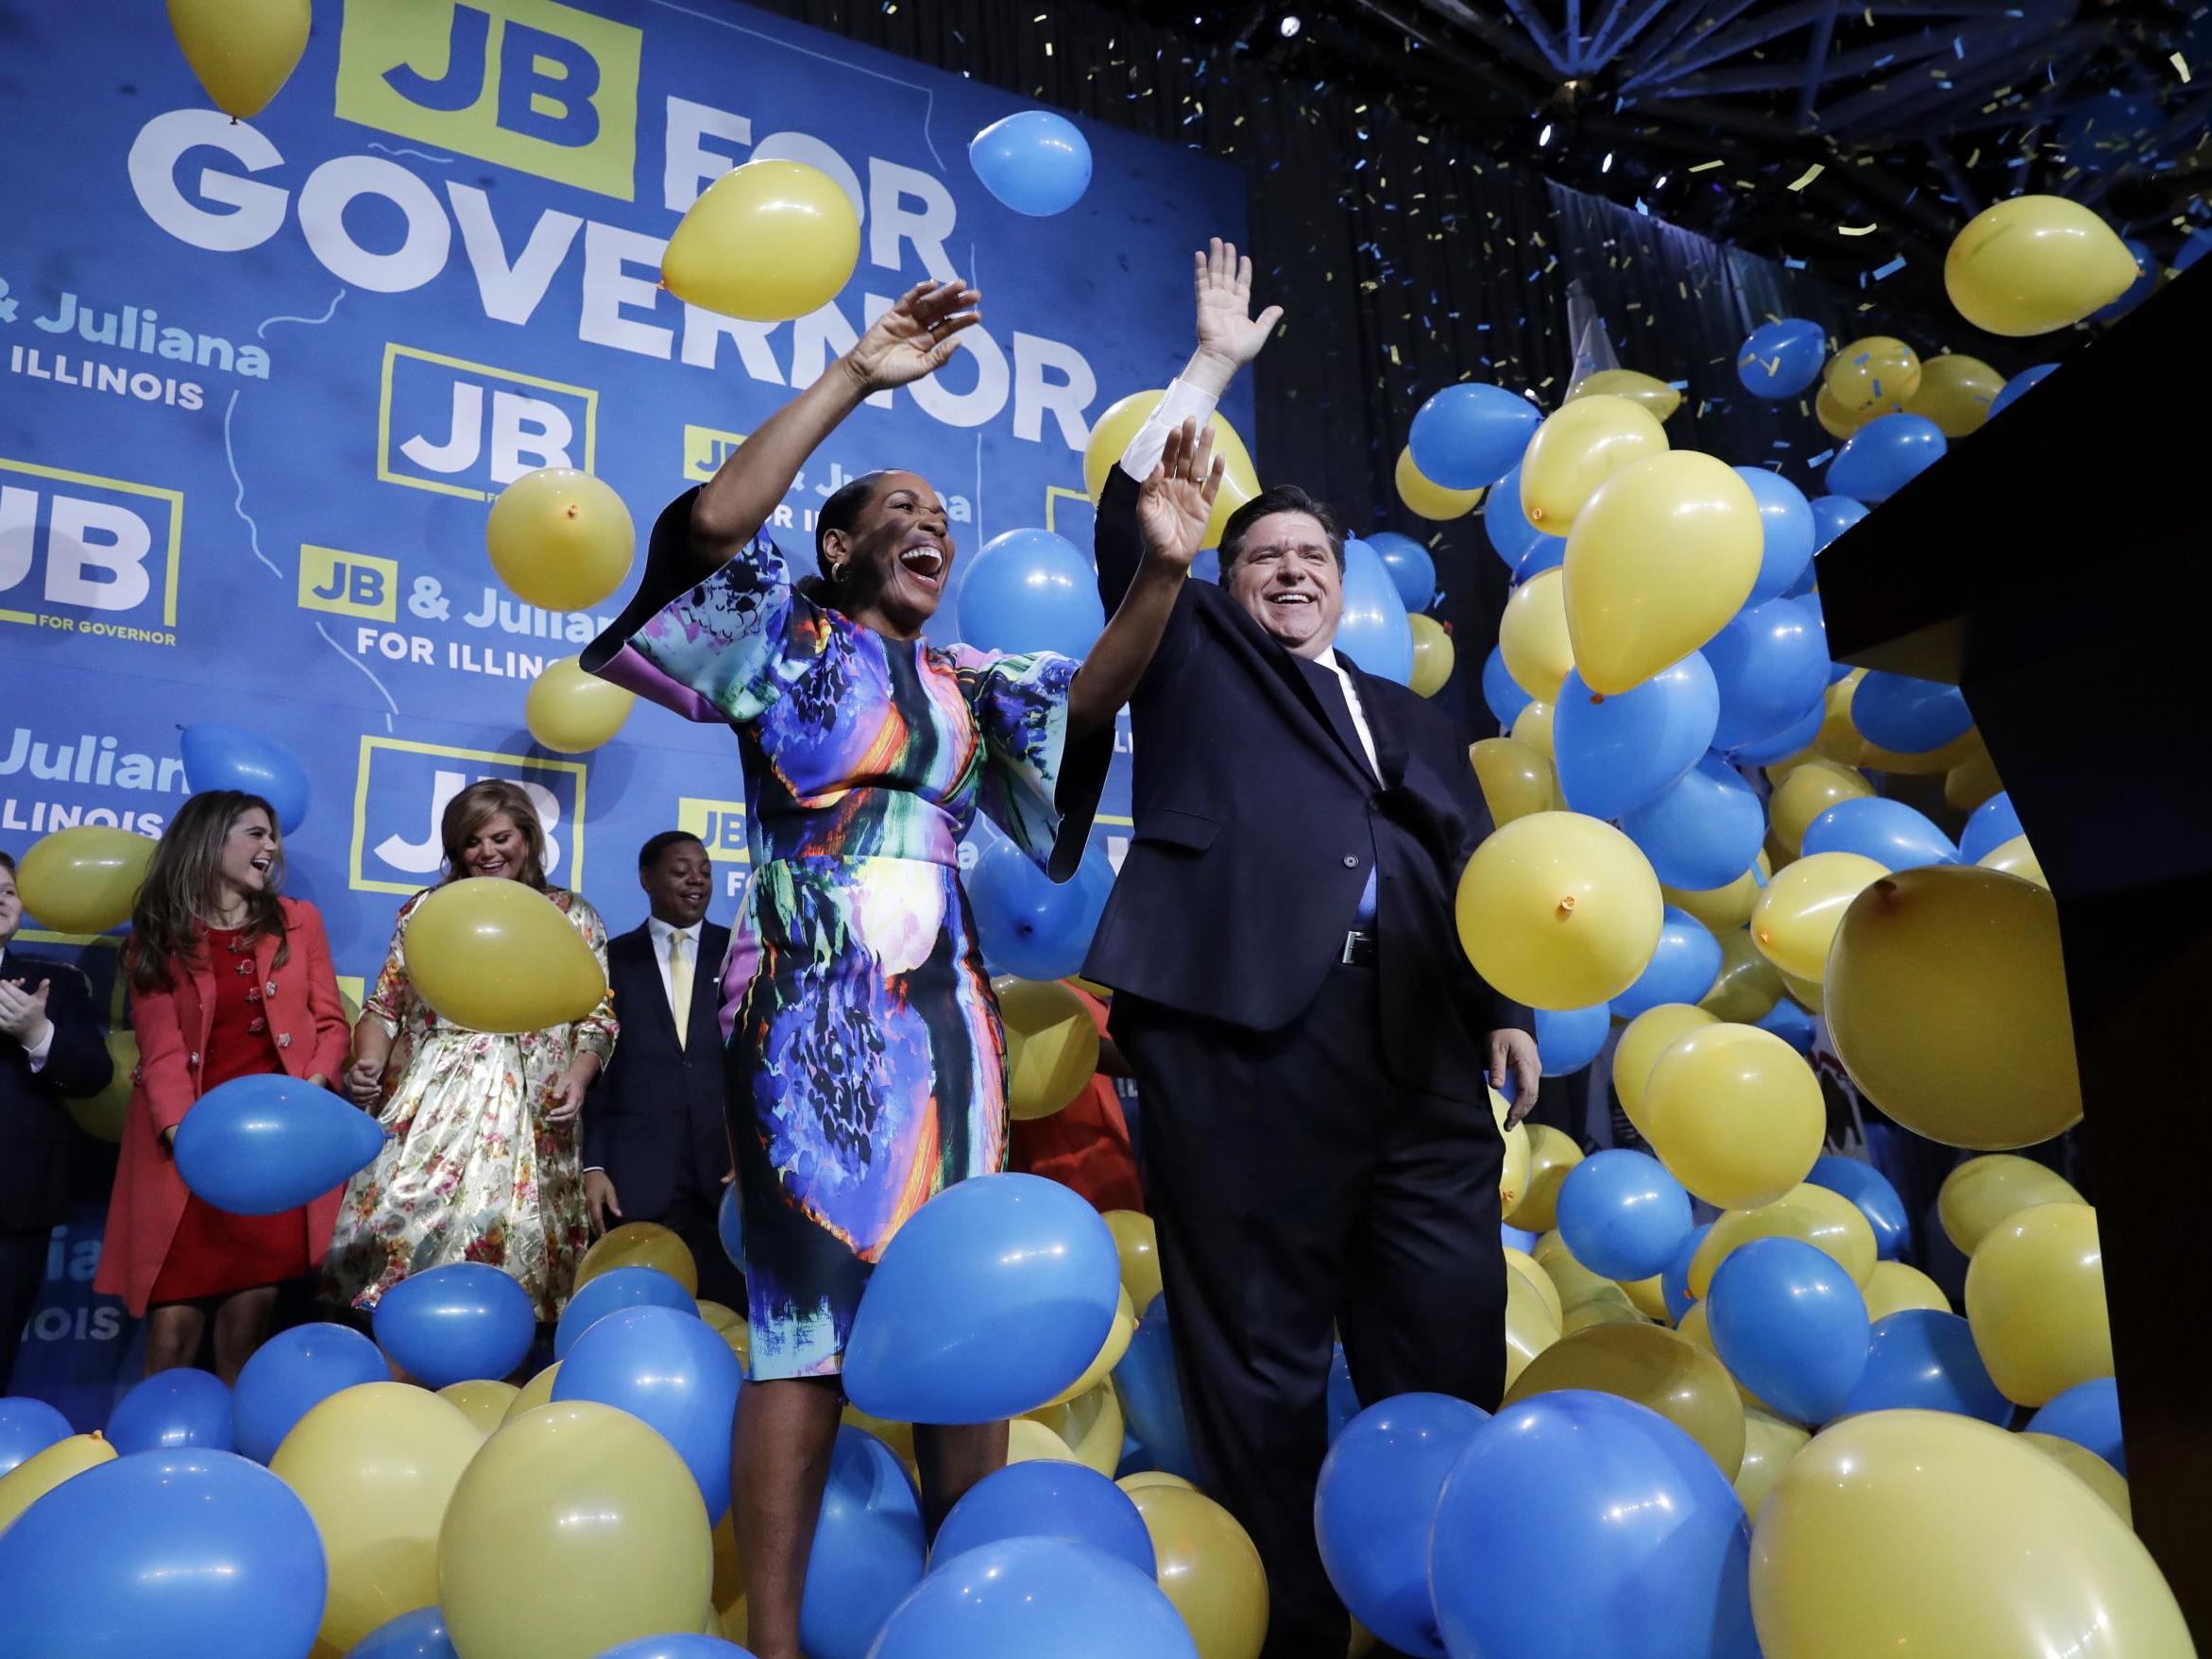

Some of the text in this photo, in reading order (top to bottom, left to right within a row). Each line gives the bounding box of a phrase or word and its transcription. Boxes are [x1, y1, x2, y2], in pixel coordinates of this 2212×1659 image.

[382, 3, 601, 148] JB
[34, 293, 271, 380] Juliana
[10, 346, 205, 412] ILLINOIS
[400, 381, 573, 485] JB
[0, 485, 151, 611] JB
[312, 562, 384, 607] JB
[408, 576, 451, 622] &
[39, 615, 178, 647] FOR GOVERNOR
[357, 627, 559, 680] FOR ILLIN
